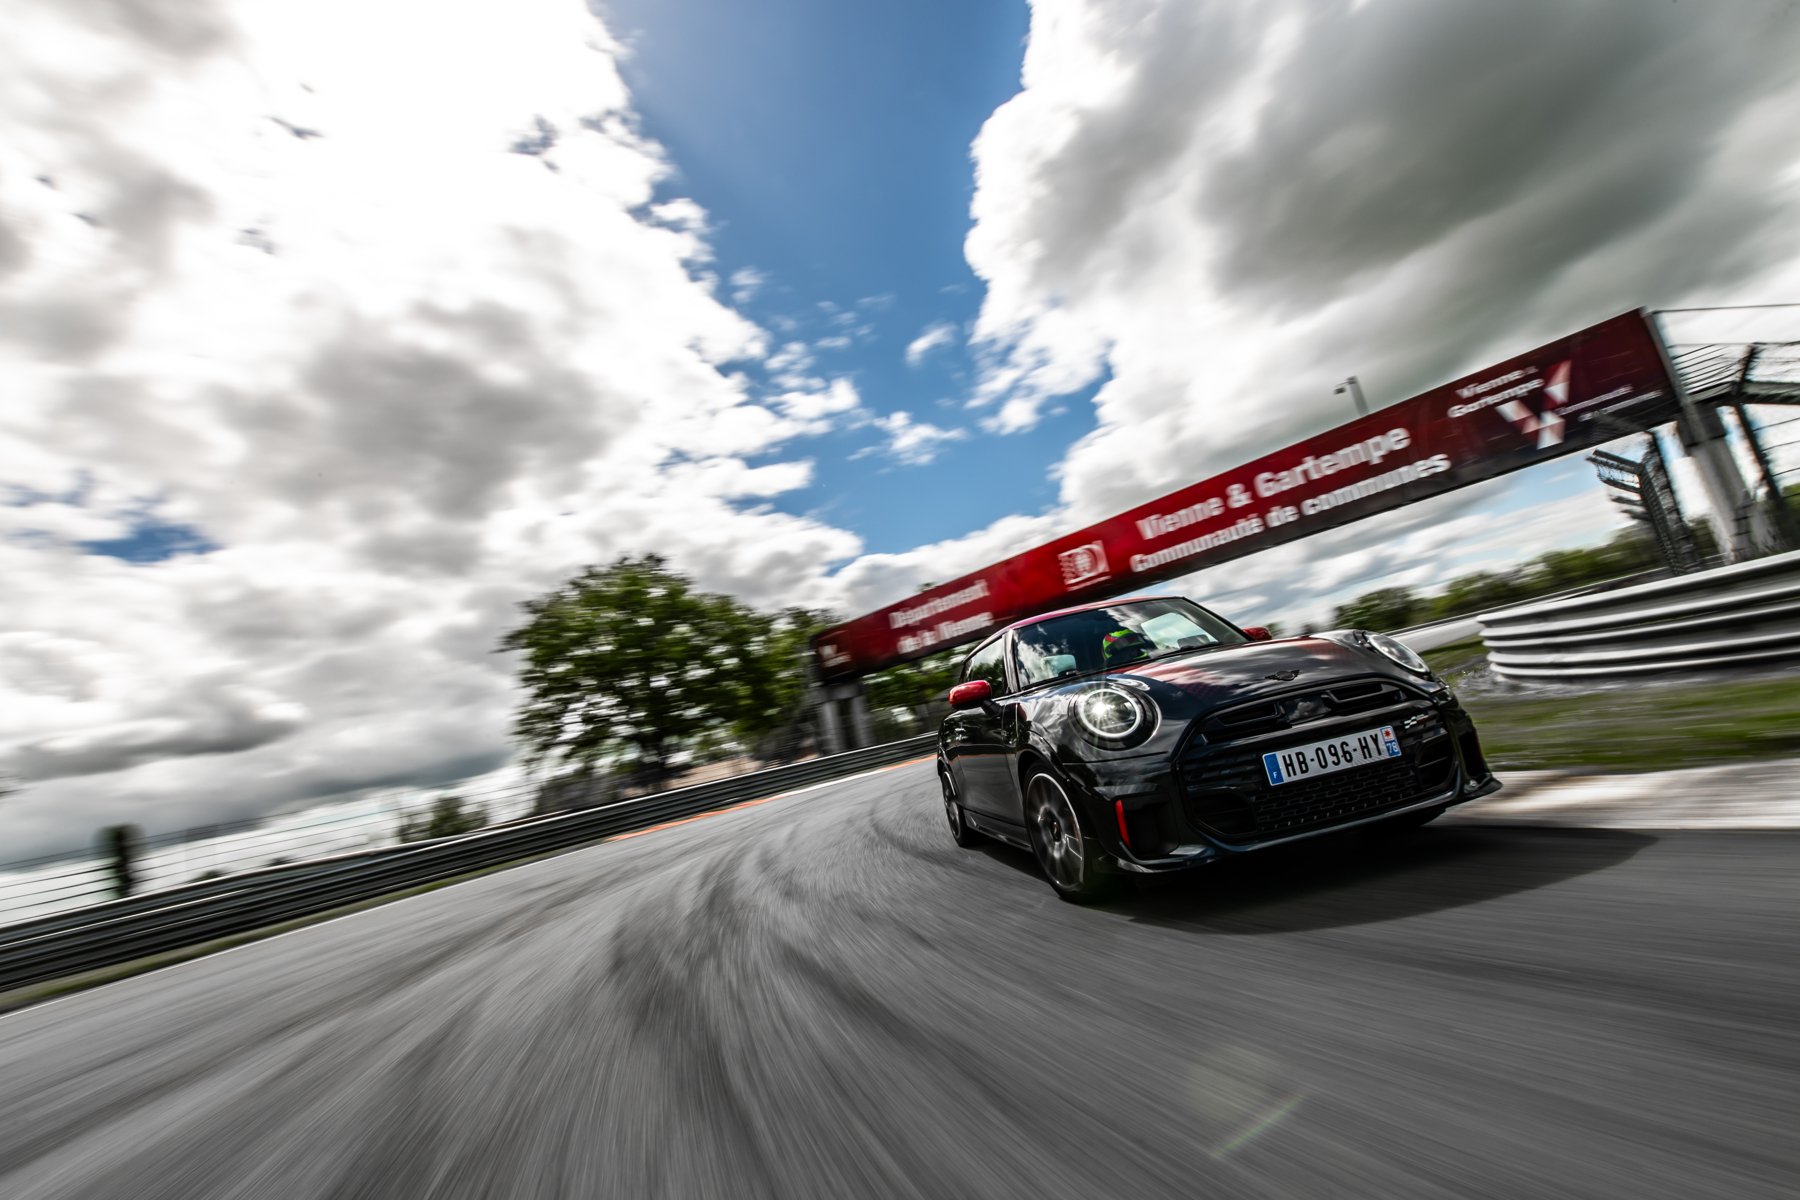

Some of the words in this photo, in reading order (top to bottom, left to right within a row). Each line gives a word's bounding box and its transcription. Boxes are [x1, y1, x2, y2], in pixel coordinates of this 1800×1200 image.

[1135, 497, 1225, 540] Vienne
[1225, 483, 1254, 509] &
[1254, 428, 1412, 498] Gartempe
[1265, 506, 1300, 528] de
[1301, 454, 1451, 516] communes
[1281, 733, 1383, 777] HB-096-HY
[1386, 742, 1399, 754] 78
